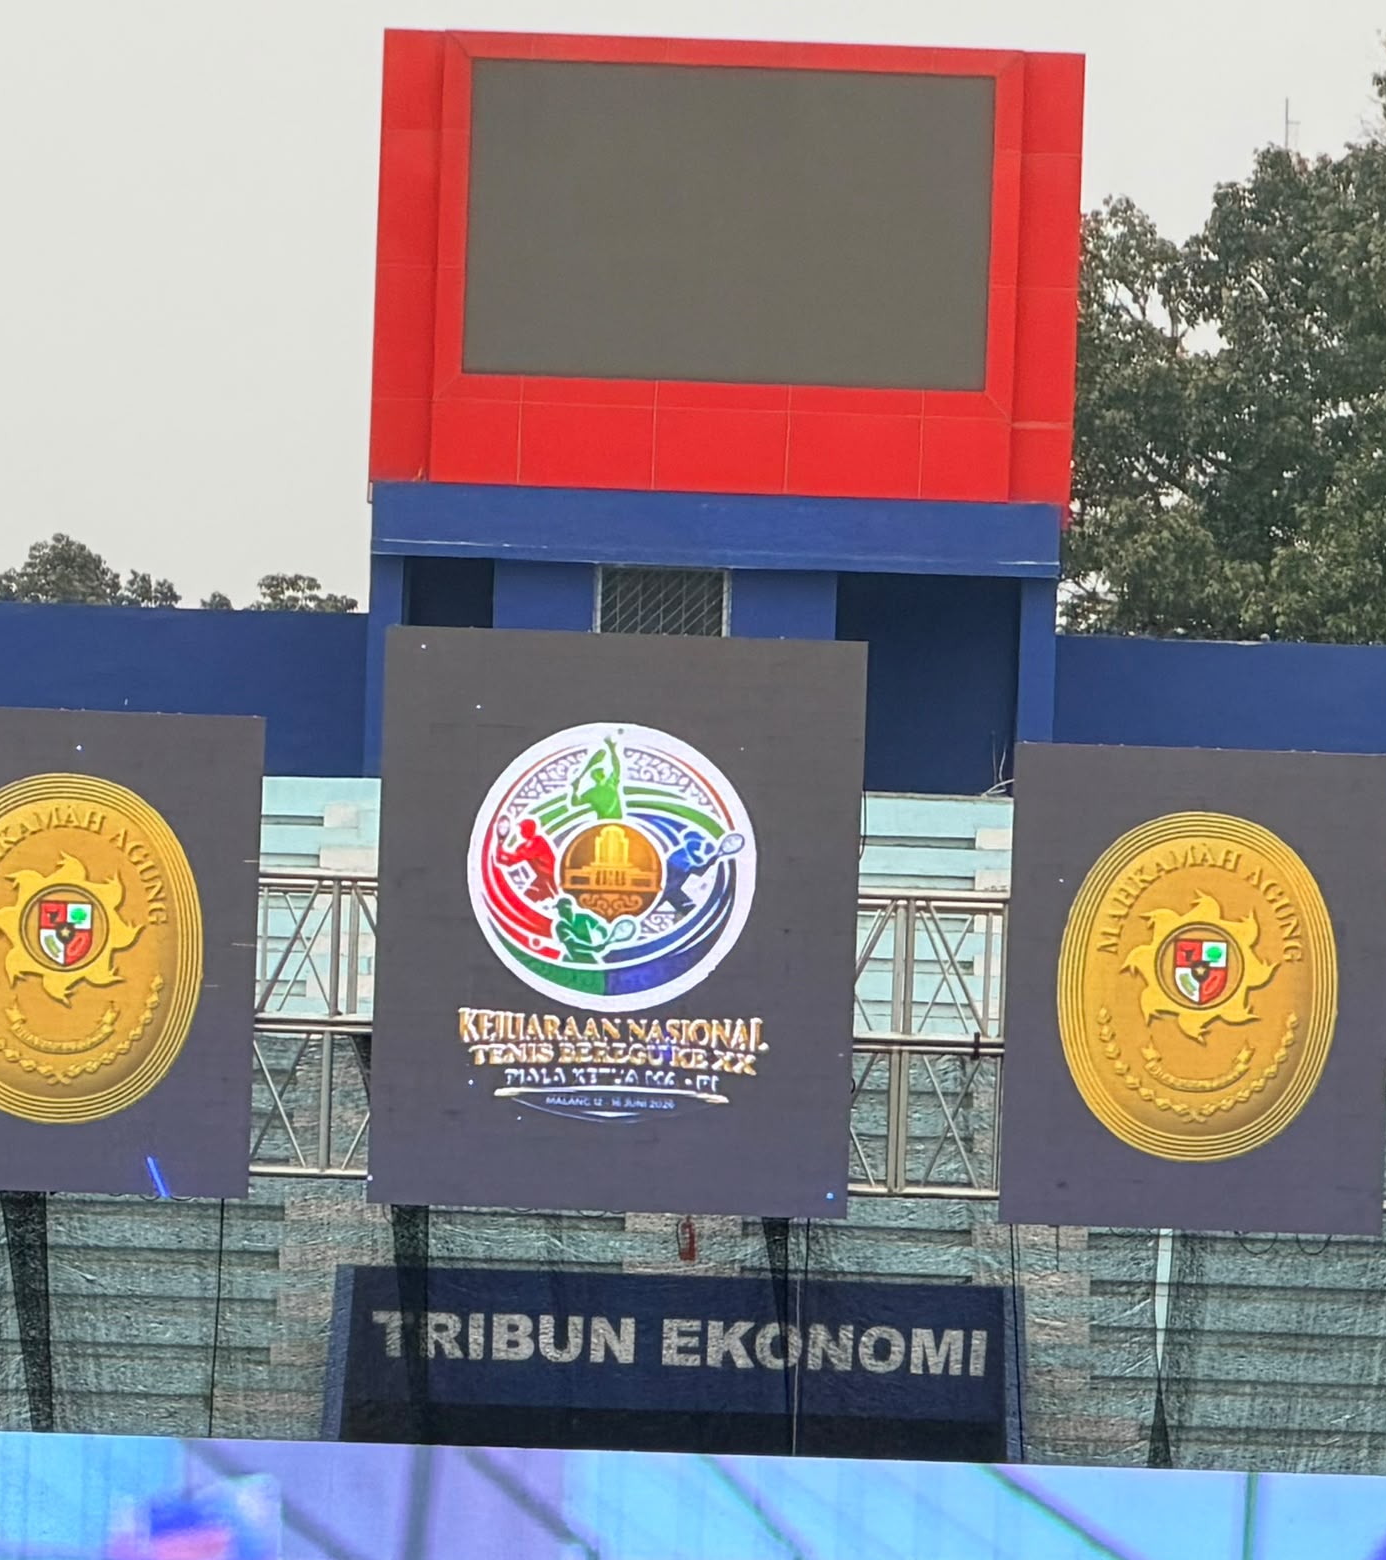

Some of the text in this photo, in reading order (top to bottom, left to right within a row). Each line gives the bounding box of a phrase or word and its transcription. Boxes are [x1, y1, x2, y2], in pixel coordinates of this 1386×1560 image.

[110, 828, 168, 926] AGUNG
[1096, 844, 1303, 964] MAHKAMAH AGUNG
[468, 1042, 555, 1066] TENIS
[626, 1017, 770, 1052] NASIONAL
[371, 1310, 989, 1377] TRIBUN EKONOMI
